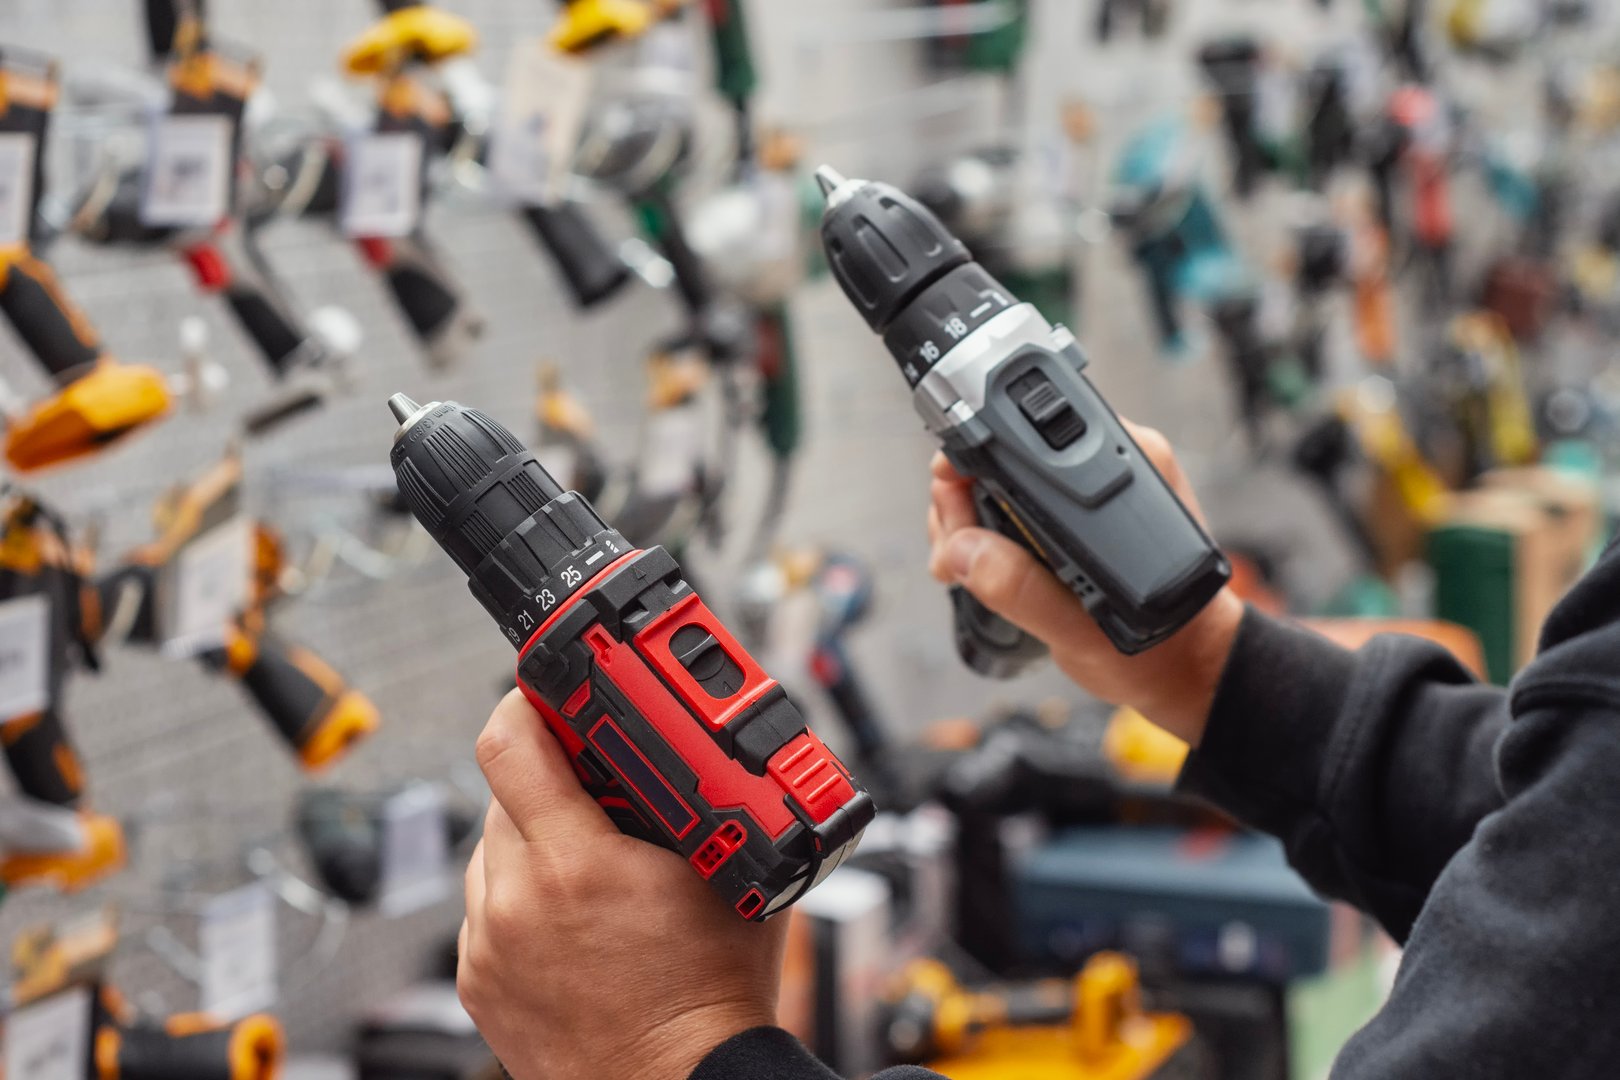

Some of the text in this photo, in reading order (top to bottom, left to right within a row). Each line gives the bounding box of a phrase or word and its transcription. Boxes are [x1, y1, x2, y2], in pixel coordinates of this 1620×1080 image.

[920, 340, 940, 363] 16
[944, 317, 967, 339] 18
[508, 565, 582, 645] 19 21 23 25
